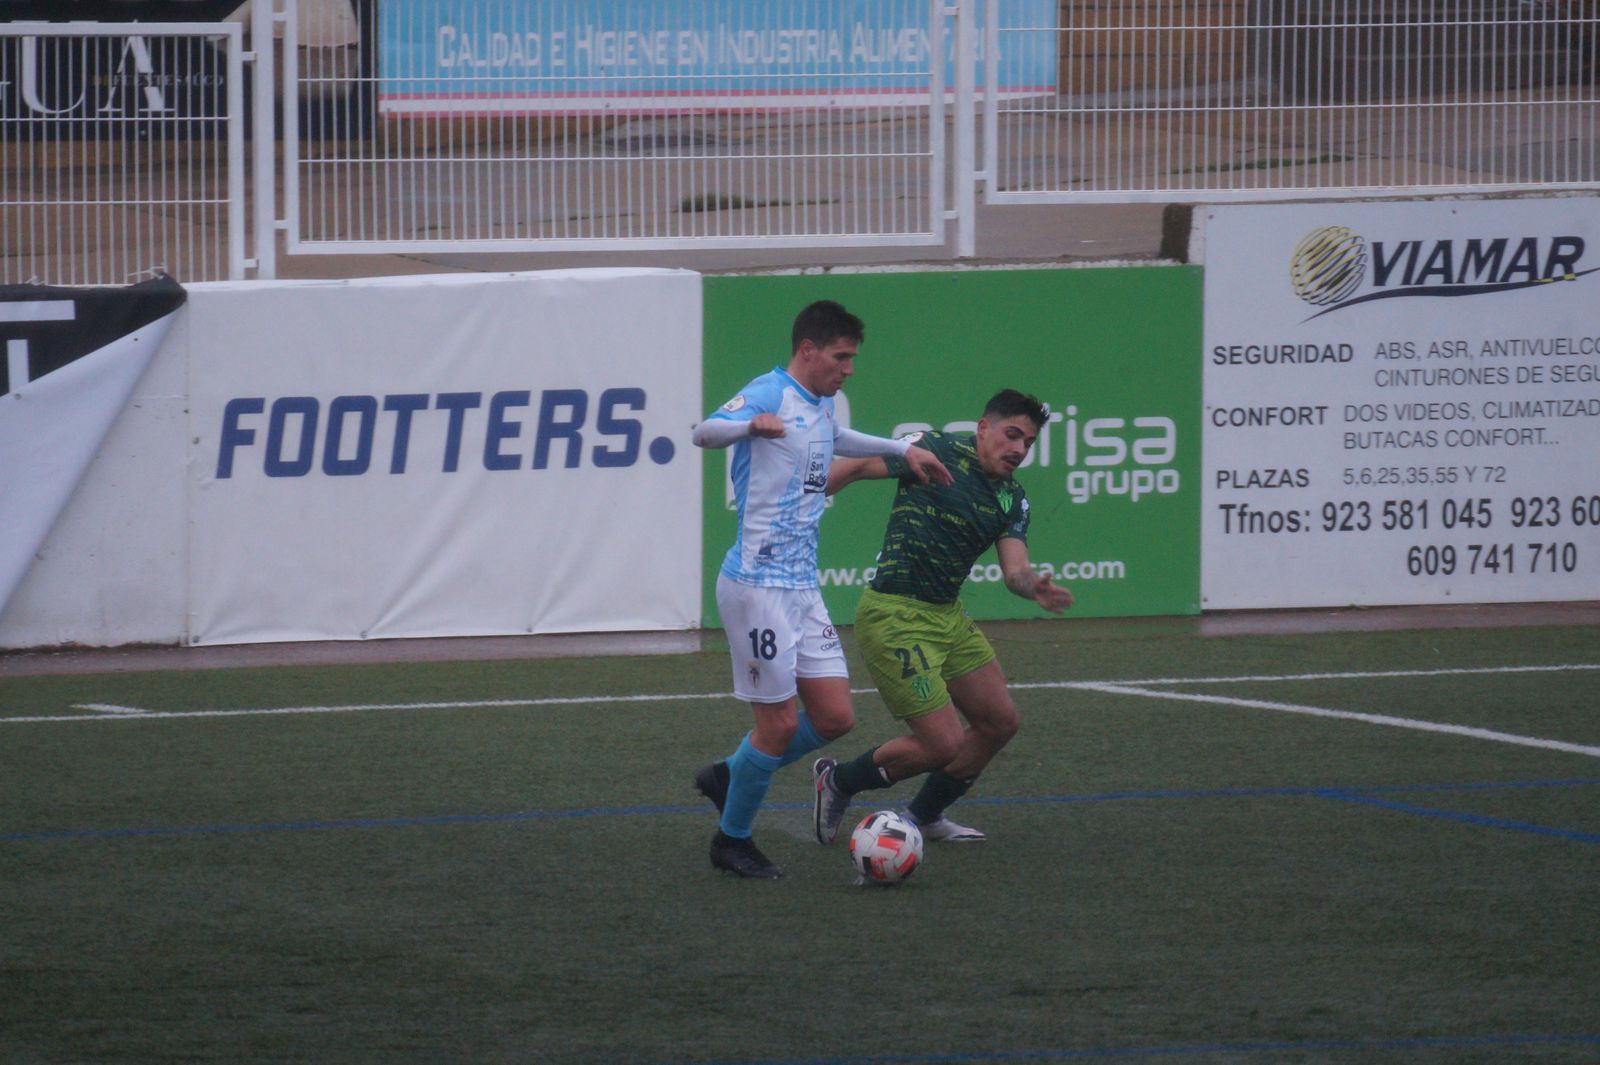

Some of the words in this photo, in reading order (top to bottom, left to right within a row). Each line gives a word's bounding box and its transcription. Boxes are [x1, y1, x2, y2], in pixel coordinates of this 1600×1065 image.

[437, 25, 541, 68] CALIDAD
[552, 31, 568, 67] E
[574, 24, 670, 66] HIGIENE
[677, 30, 709, 66] EN
[718, 22, 842, 64] INDUSTRIA
[1371, 236, 1585, 287] VIAMAR
[1212, 343, 1355, 365] SEGURIDAD
[1374, 342, 1421, 363] ABS,
[1426, 340, 1474, 362] ASR,
[1374, 366, 1510, 387] CINTURONES
[1516, 365, 1544, 384] DE
[1211, 406, 1329, 427] CONFORT
[1343, 403, 1388, 423] DOS
[1394, 402, 1477, 423] VIDEOS,
[1343, 430, 1439, 450] BUTACAS
[1444, 427, 1561, 449] CONFORT...
[1066, 468, 1181, 504] grupo
[1215, 468, 1311, 489] PLAZAS
[1464, 466, 1478, 483] Y
[1483, 465, 1507, 484] 72
[1218, 502, 1311, 534] Tfnos:
[1322, 501, 1372, 532] 923
[1381, 499, 1430, 530] 581
[1441, 498, 1493, 529] 045
[1511, 496, 1561, 528] 923
[1407, 544, 1457, 576] 609
[1467, 543, 1516, 575] 741
[1527, 541, 1578, 574] 710
[749, 628, 778, 661] 18
[895, 643, 931, 680] 21
